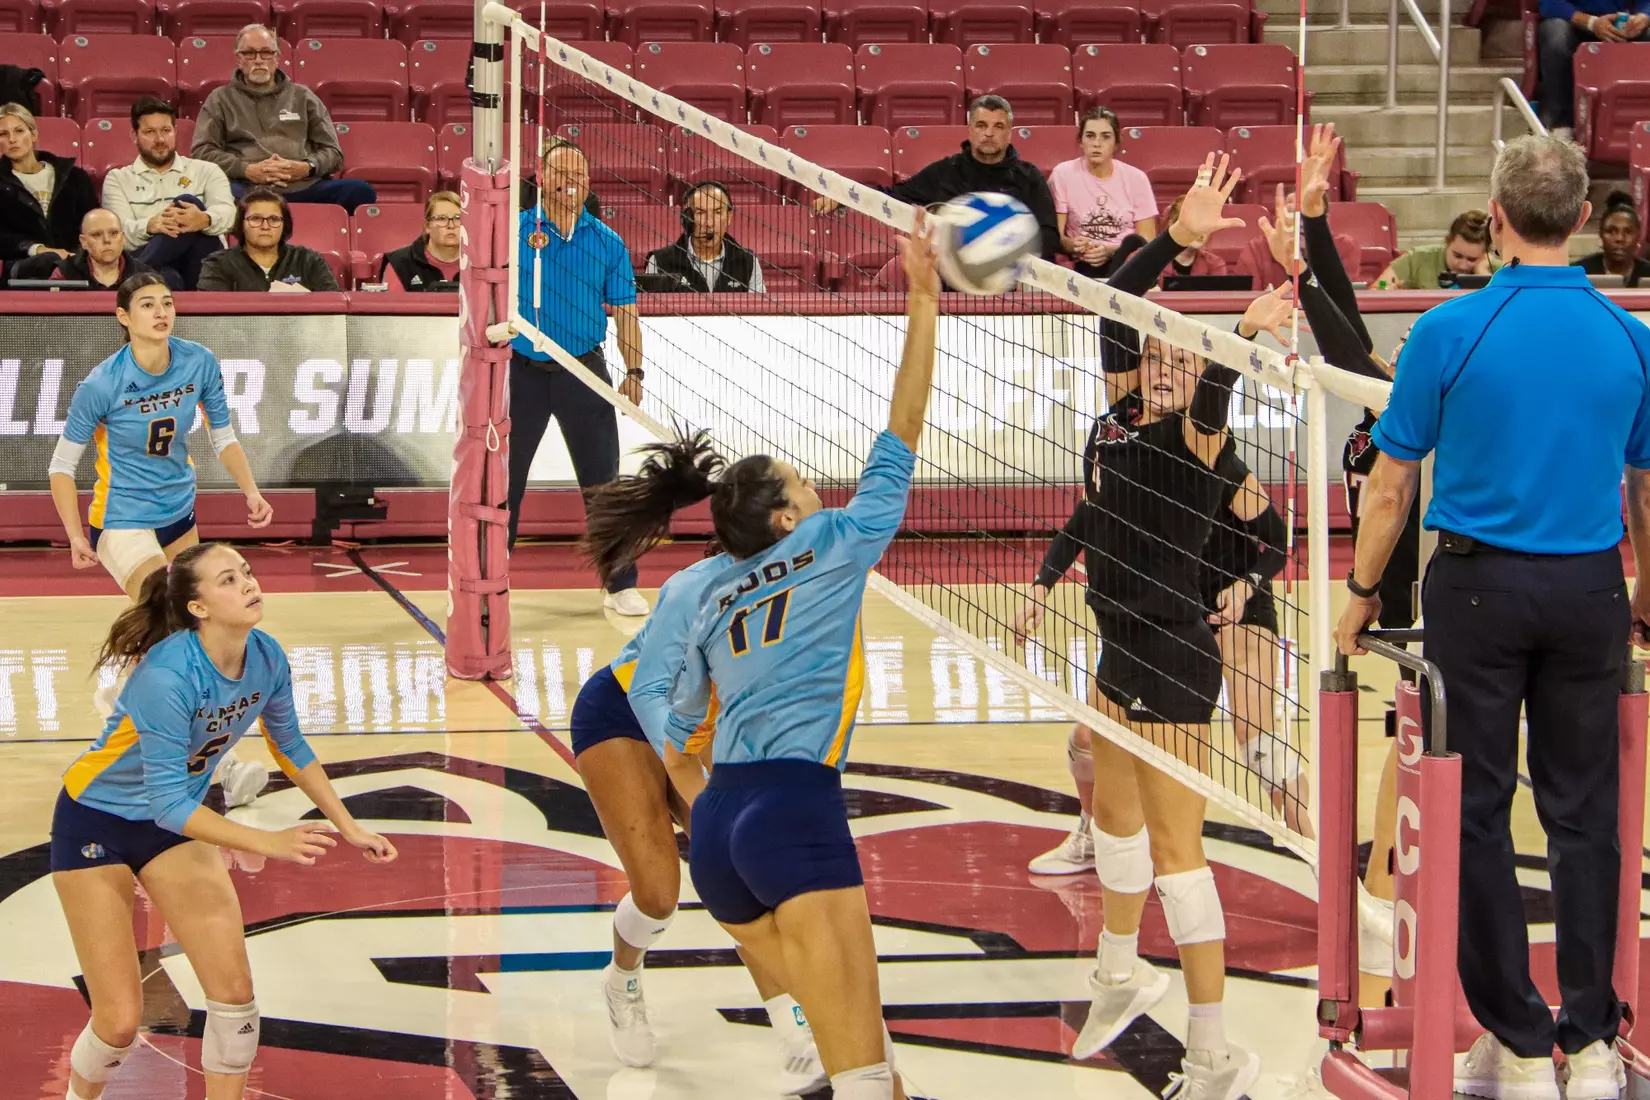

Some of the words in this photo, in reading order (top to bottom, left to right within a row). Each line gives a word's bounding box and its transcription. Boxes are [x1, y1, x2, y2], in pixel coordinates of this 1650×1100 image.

[123, 383, 195, 406] KANSAS
[140, 397, 181, 414] CITY
[287, 357, 459, 435] SUM
[147, 416, 176, 457] 6
[727, 587, 794, 658] 17
[196, 691, 261, 721] KANSAS
[206, 711, 246, 732] CITY
[186, 732, 232, 774] 5
